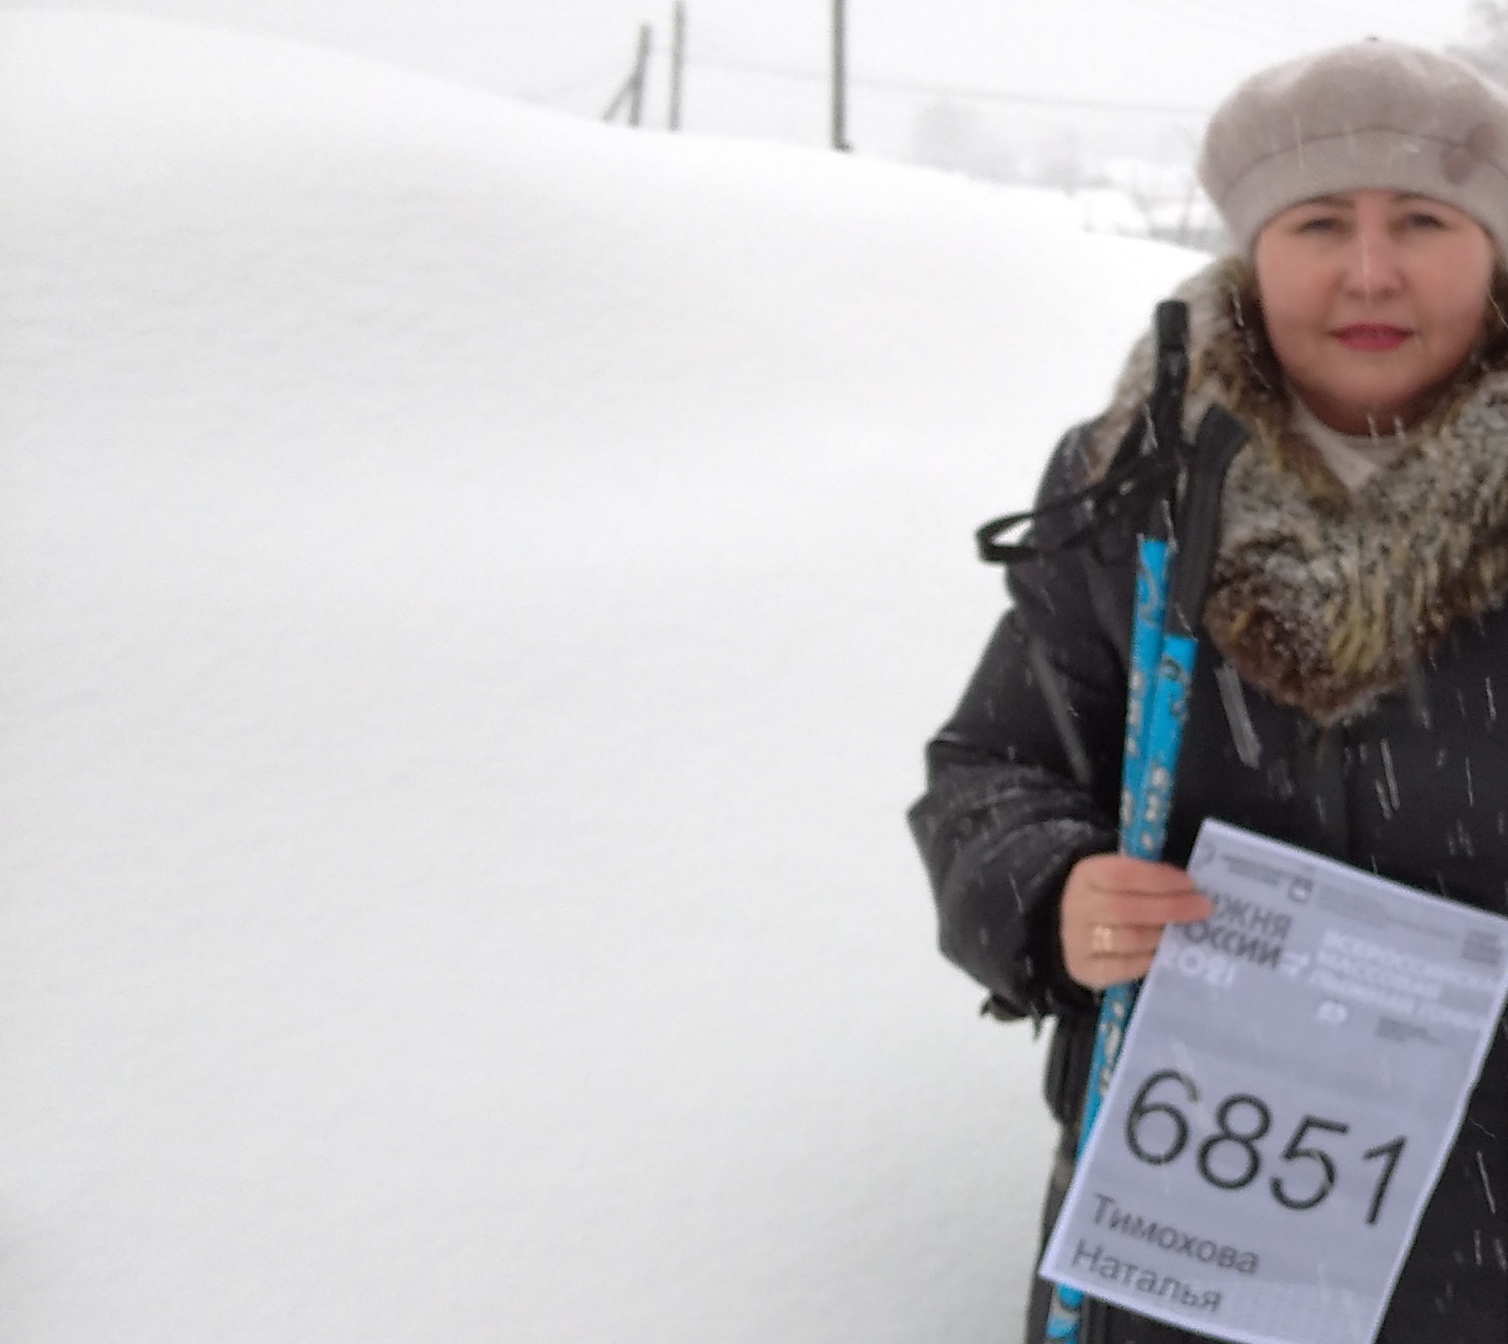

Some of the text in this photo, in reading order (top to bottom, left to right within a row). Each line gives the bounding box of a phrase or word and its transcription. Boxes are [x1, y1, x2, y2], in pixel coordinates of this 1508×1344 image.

[1173, 920, 1283, 970] ОССИИ
[1202, 888, 1293, 940] ЖНЯ
[1124, 1067, 1408, 1228] 6851
[1093, 1191, 1259, 1274] Тимохова
[1071, 1237, 1222, 1312] Наталья
